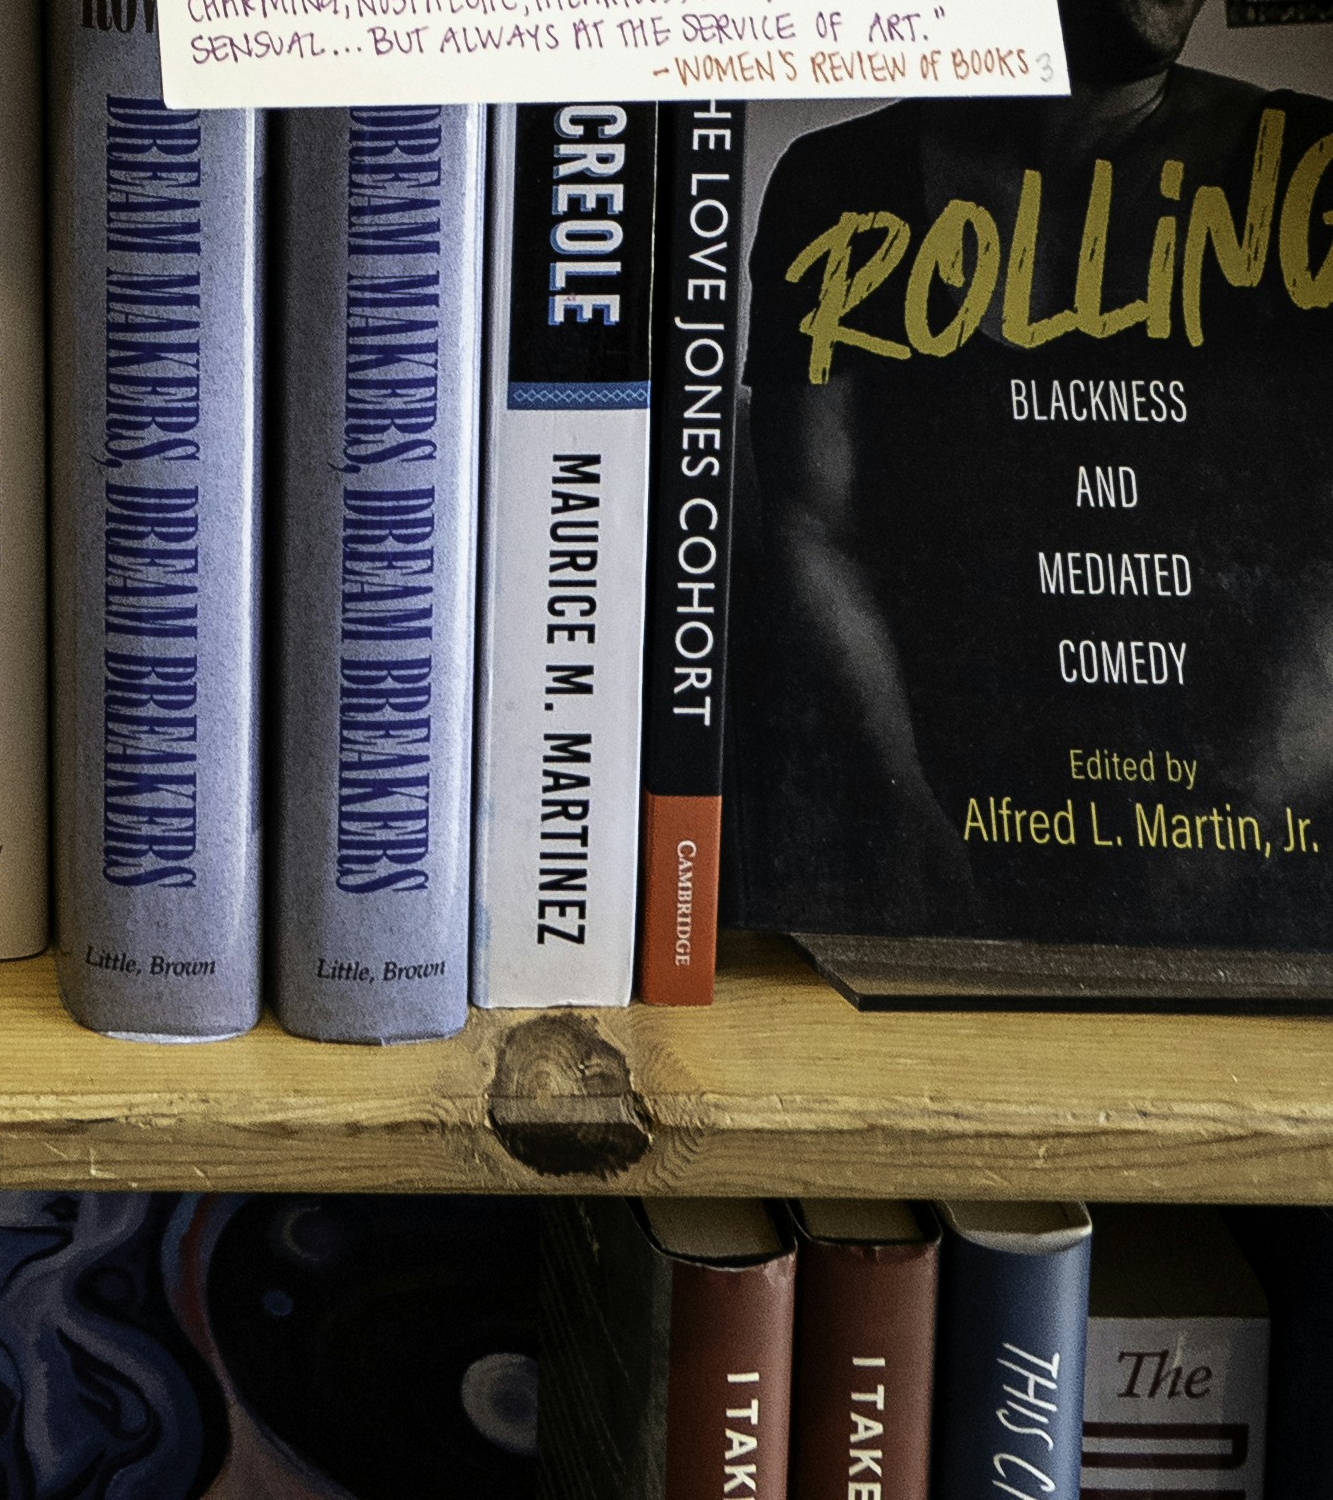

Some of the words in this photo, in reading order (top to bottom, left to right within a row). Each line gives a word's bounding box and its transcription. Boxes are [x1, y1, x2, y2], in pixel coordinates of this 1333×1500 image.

[1011, 379, 1187, 423] BLACKNESS
[1076, 466, 1138, 508] AND
[1038, 552, 1192, 596] MEDIATED
[1059, 639, 1186, 685] COMEDY
[964, 797, 1076, 845] Alfred
[1090, 802, 1122, 846] L.
[1135, 803, 1271, 858] Martin,
[1284, 807, 1318, 852] Jr.
[676, 840, 697, 965] CAMBRIDGE
[84, 945, 141, 980] Little,
[149, 955, 219, 979] Brown
